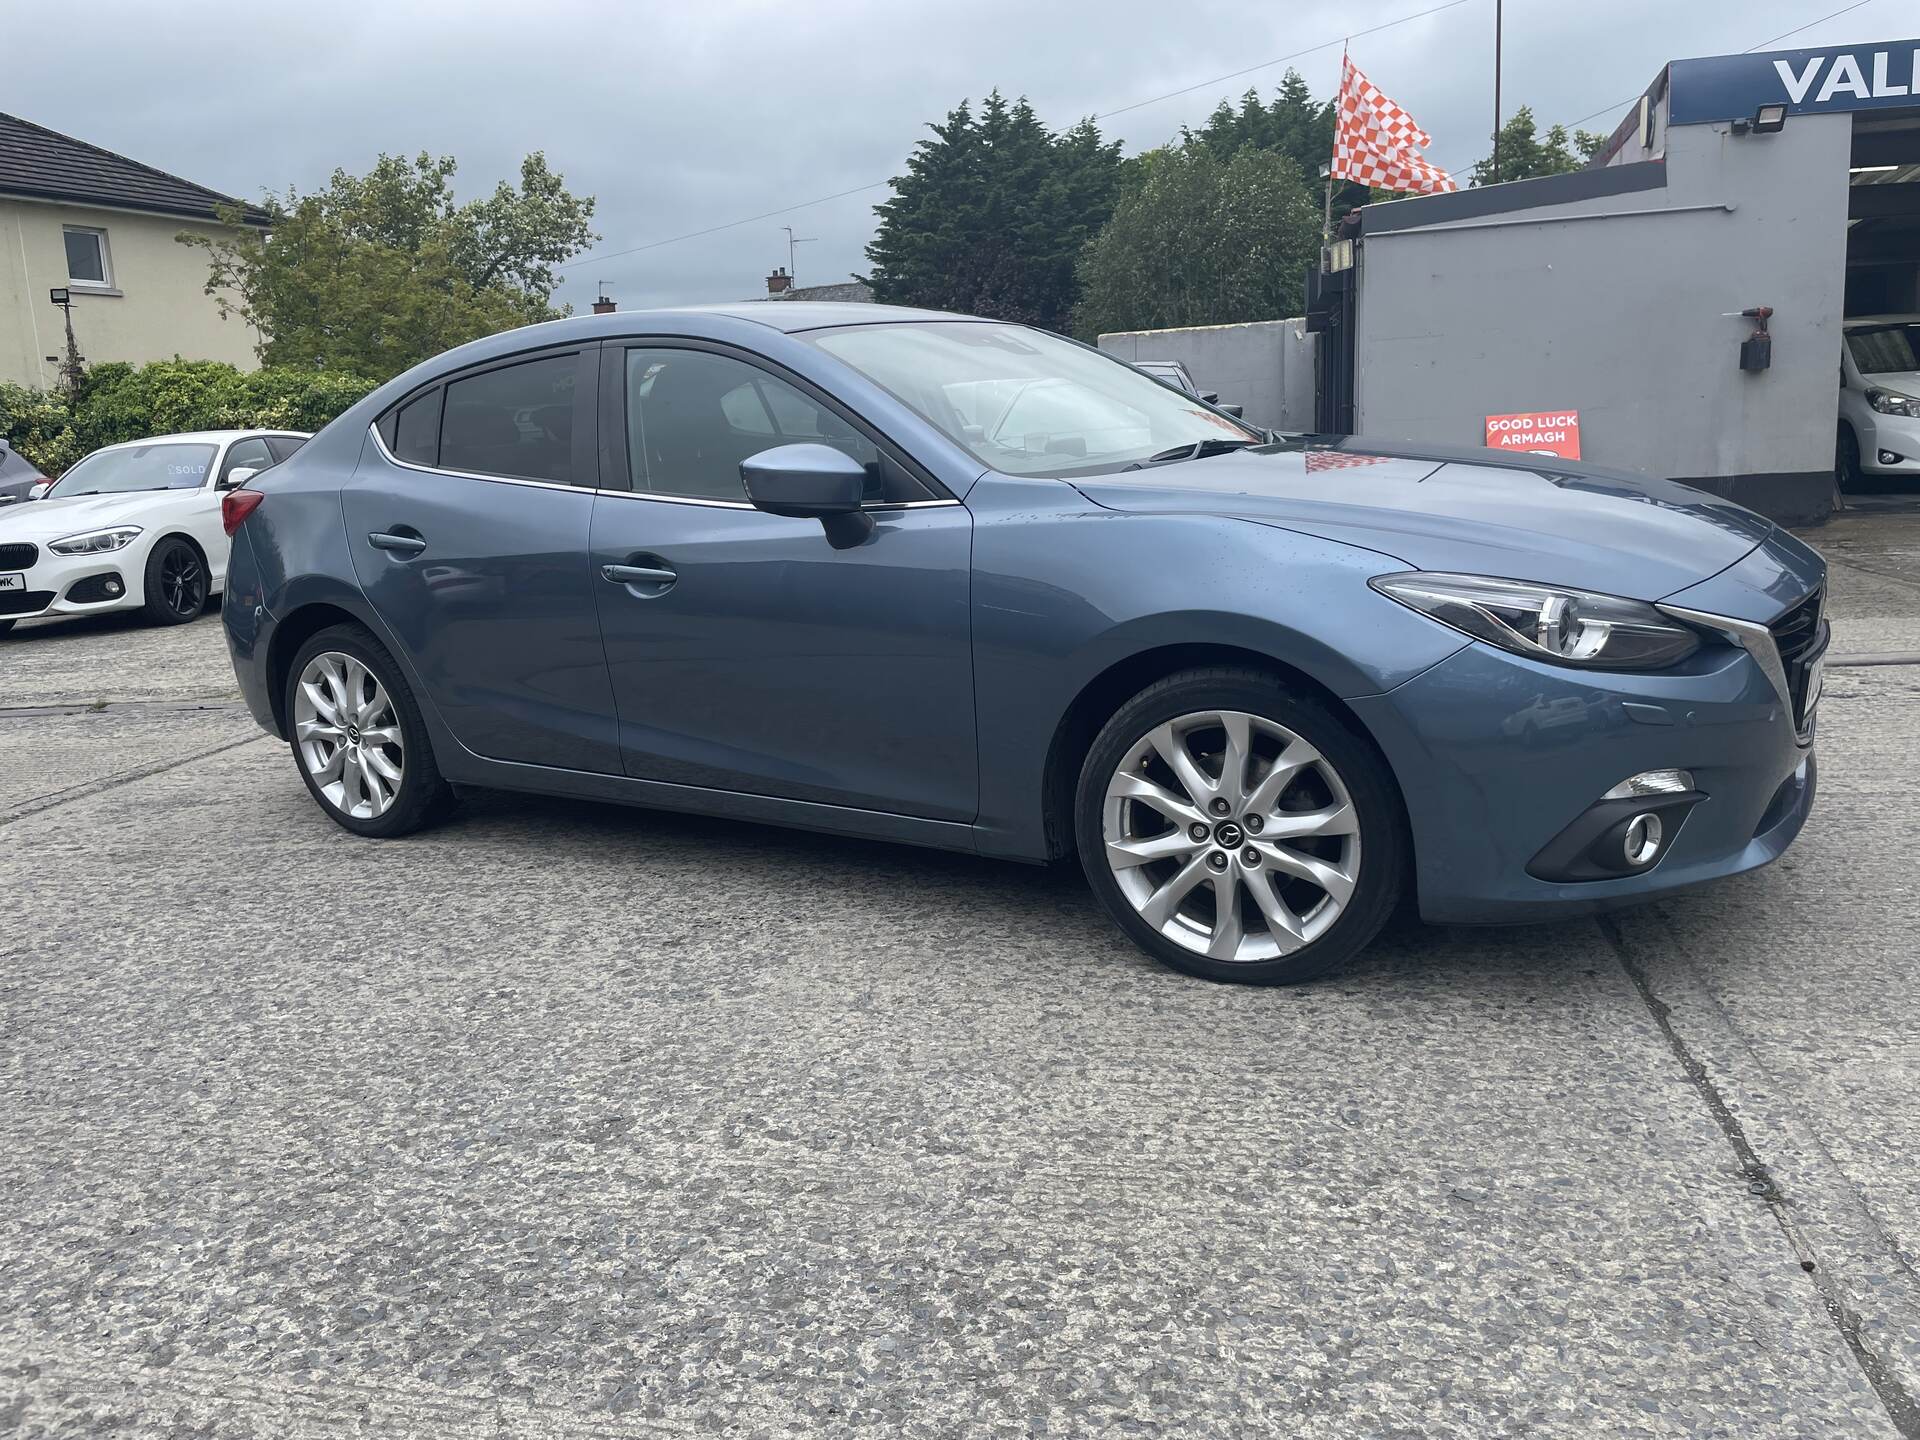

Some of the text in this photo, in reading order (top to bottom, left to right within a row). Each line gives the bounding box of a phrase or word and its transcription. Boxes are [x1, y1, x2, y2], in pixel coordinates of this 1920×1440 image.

[1772, 48, 1920, 104] VAL
[1488, 415, 1577, 431] GOOD LUCK
[1501, 431, 1565, 446] ARMAGH
